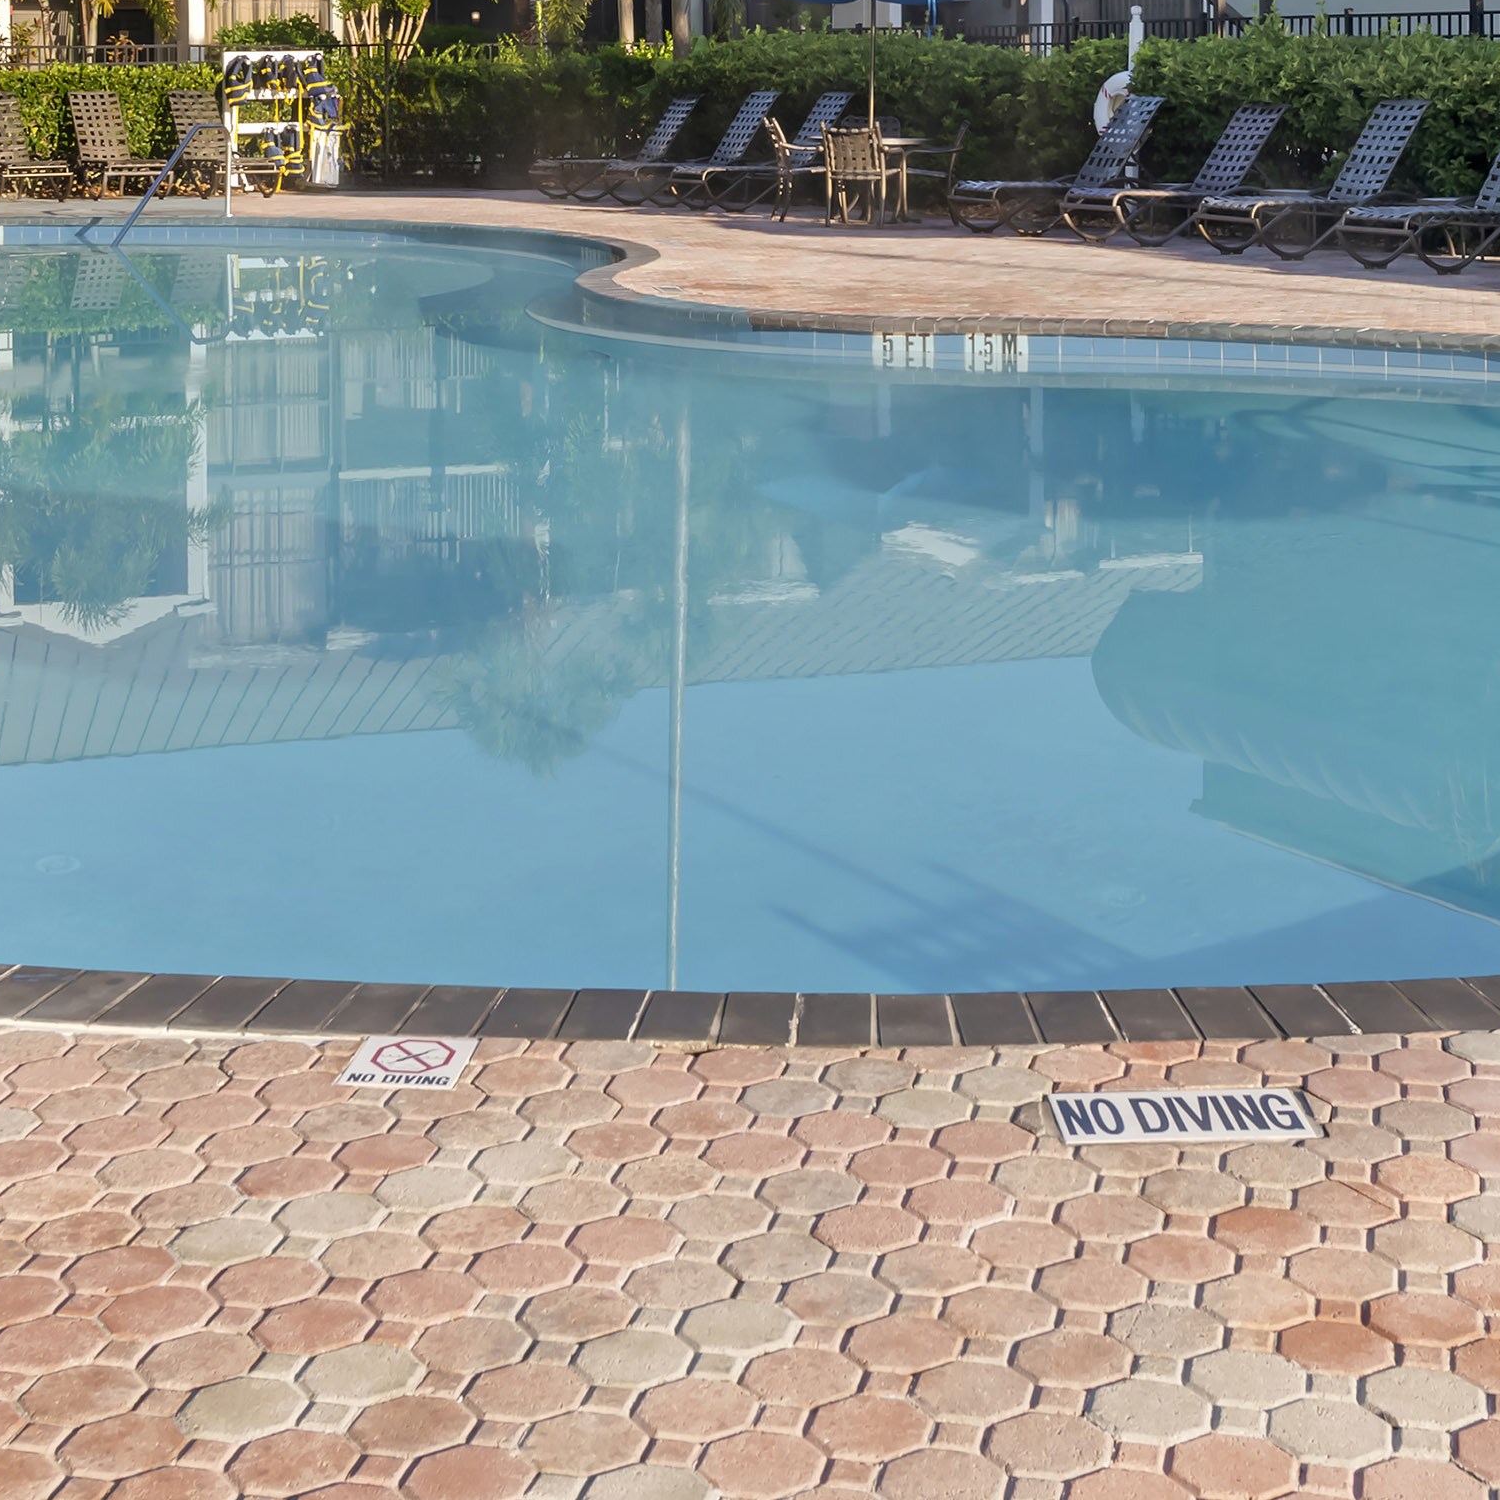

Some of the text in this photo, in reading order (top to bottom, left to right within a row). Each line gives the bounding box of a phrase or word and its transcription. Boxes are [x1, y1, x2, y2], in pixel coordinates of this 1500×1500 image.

[882, 332, 894, 353] 5
[967, 332, 994, 355] 1.5
[346, 1072, 451, 1086] NO DIVING
[1056, 1093, 1306, 1136] NO DIVING
